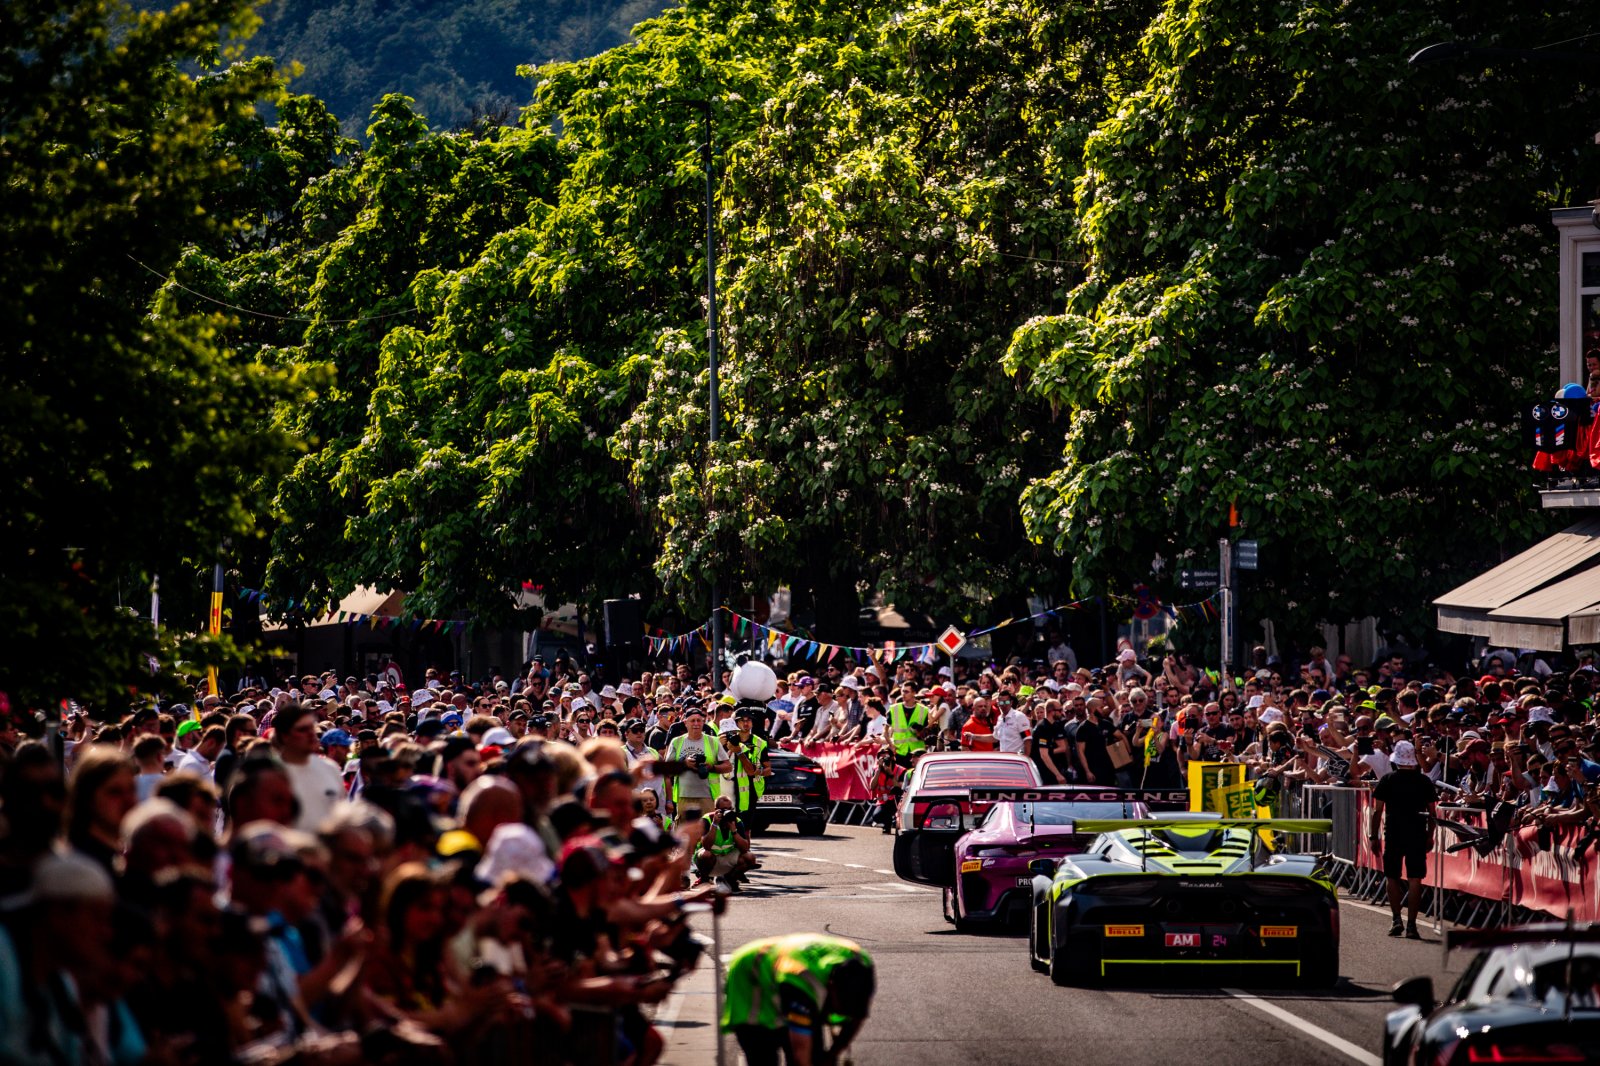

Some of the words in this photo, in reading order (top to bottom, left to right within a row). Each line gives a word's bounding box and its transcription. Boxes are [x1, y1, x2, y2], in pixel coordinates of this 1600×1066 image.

[1108, 926, 1142, 936] PIRELLI
[1263, 927, 1297, 936] PIRELLI
[1172, 934, 1194, 946] AM
[1212, 934, 1227, 947] 24
